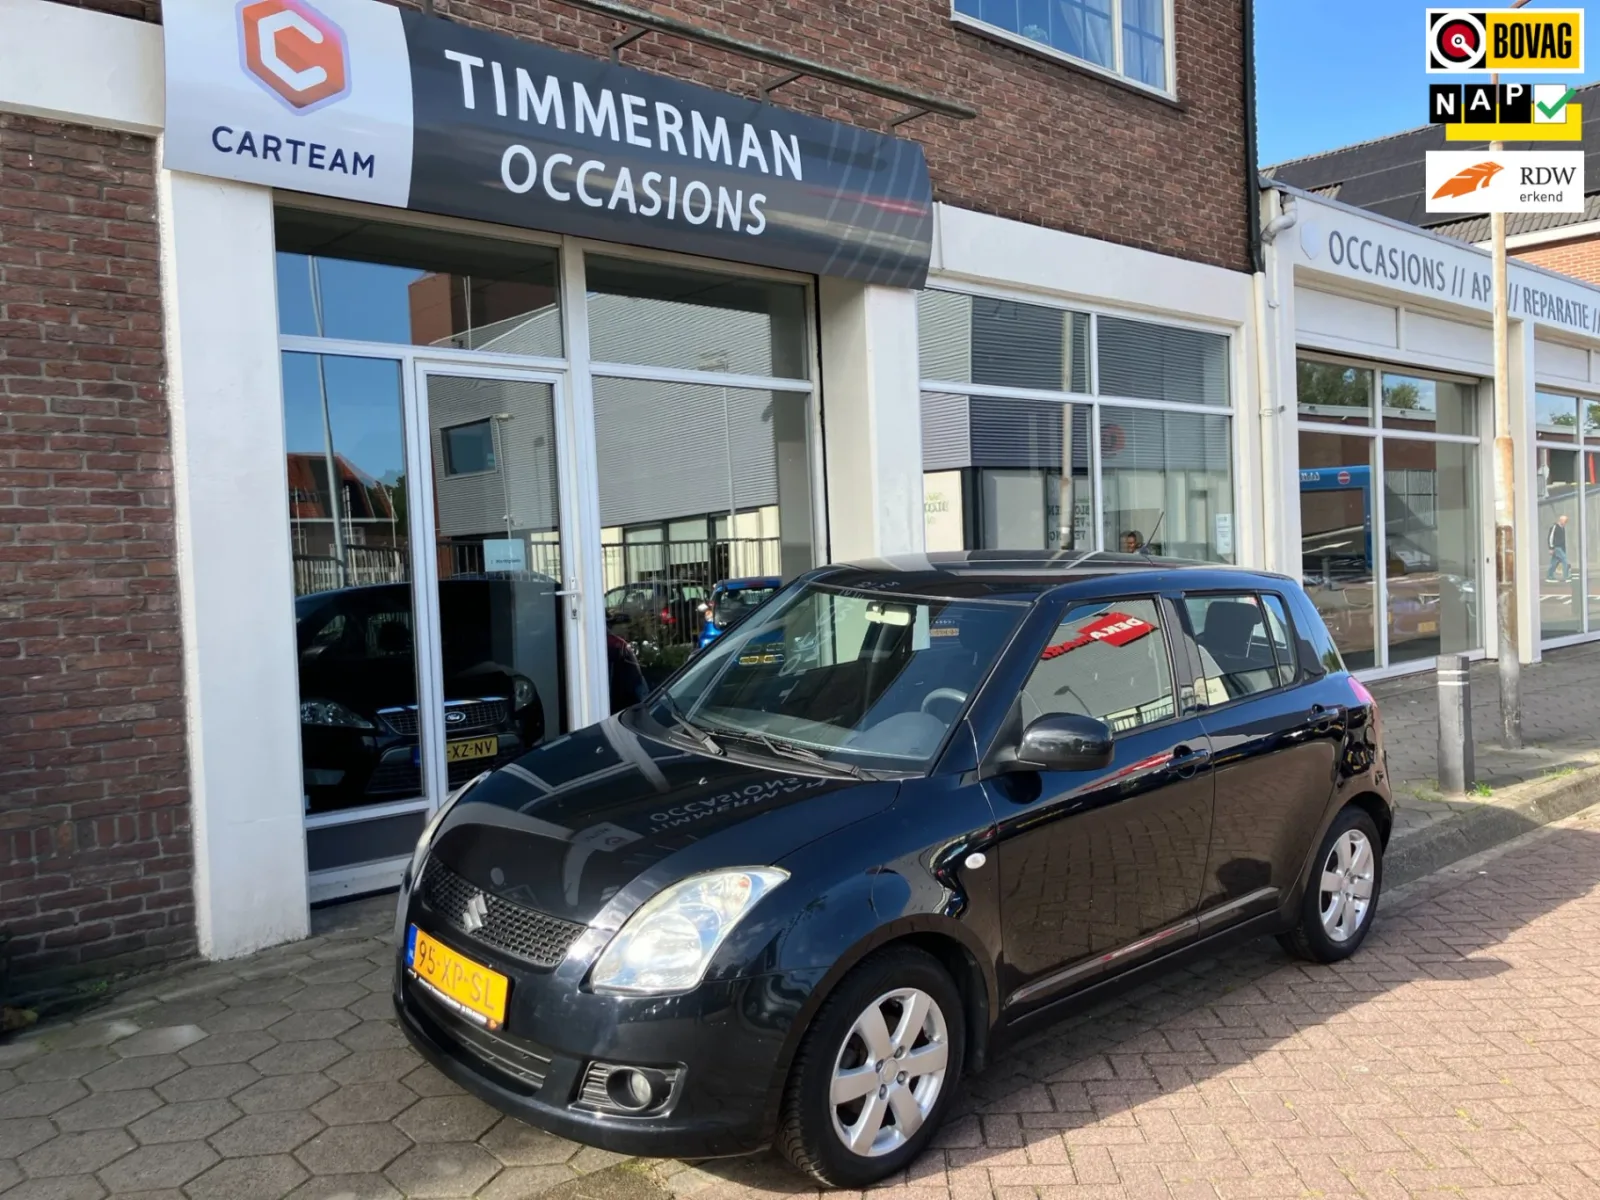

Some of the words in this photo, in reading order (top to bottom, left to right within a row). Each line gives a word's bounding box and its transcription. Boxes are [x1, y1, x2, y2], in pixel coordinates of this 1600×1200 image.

[211, 124, 375, 179] CARTEAM
[444, 49, 803, 182] TIMMERMAN
[501, 144, 767, 236] OCCASIONS
[1329, 230, 1446, 291] OCCASIONS
[1471, 272, 1492, 303] AP
[1523, 286, 1590, 330] REPARATIE
[447, 740, 493, 760] -XZ-NV
[418, 939, 495, 1012] 95-XP-SL
